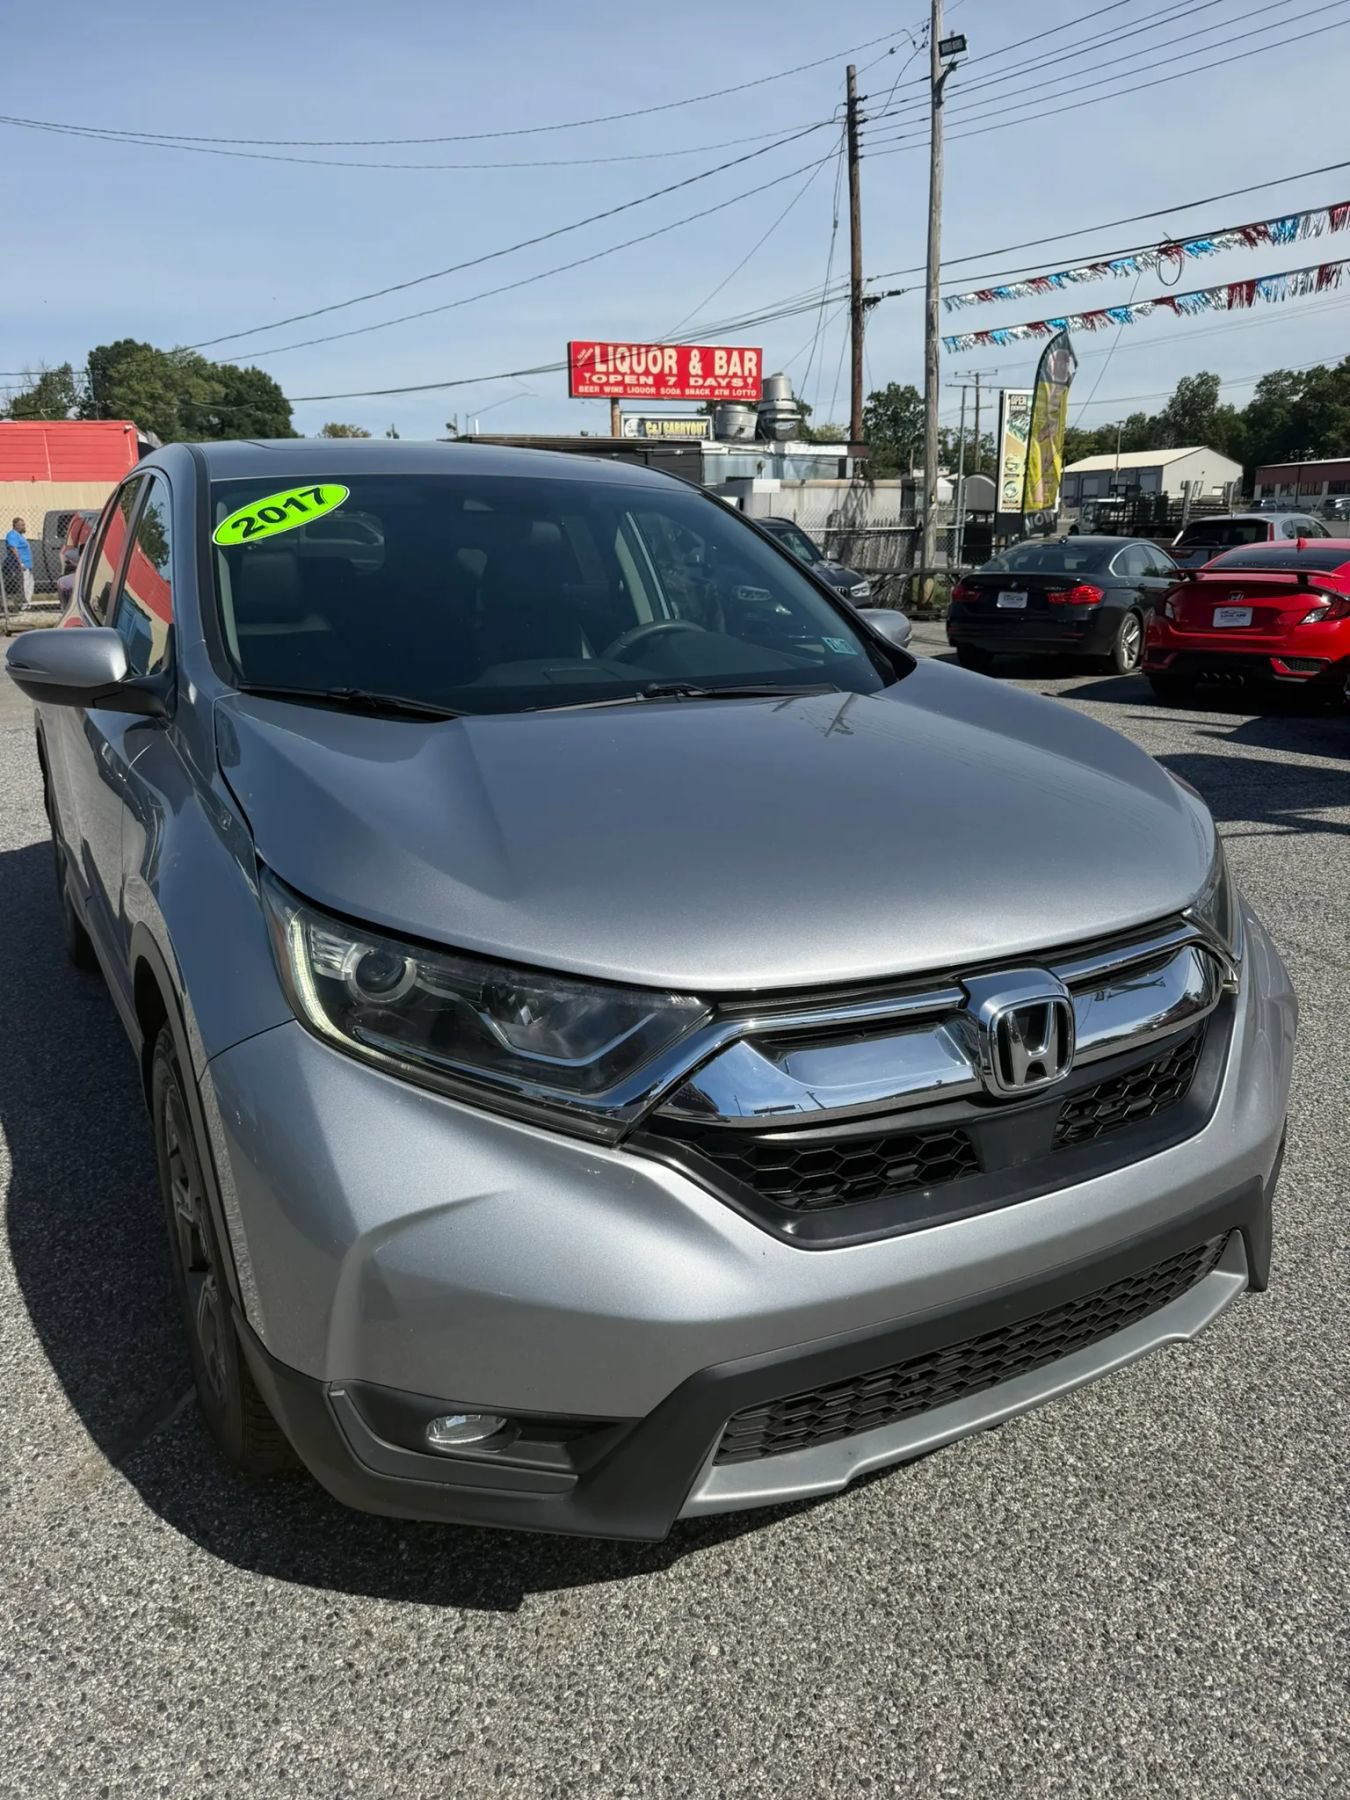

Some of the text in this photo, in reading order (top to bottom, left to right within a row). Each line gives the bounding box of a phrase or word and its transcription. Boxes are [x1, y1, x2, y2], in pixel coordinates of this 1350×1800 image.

[594, 345, 757, 377] LIQUOR & BAR
[591, 374, 654, 385] OPEN
[665, 376, 678, 386] 7
[578, 385, 600, 393] BEER
[603, 386, 624, 394] WINE
[627, 386, 656, 395] LIQUOR
[660, 387, 681, 395] SODA
[685, 388, 710, 396] SNACK
[732, 389, 757, 397] LOTTO
[663, 421, 707, 436] CARRYOUT
[231, 487, 326, 538] 2017
